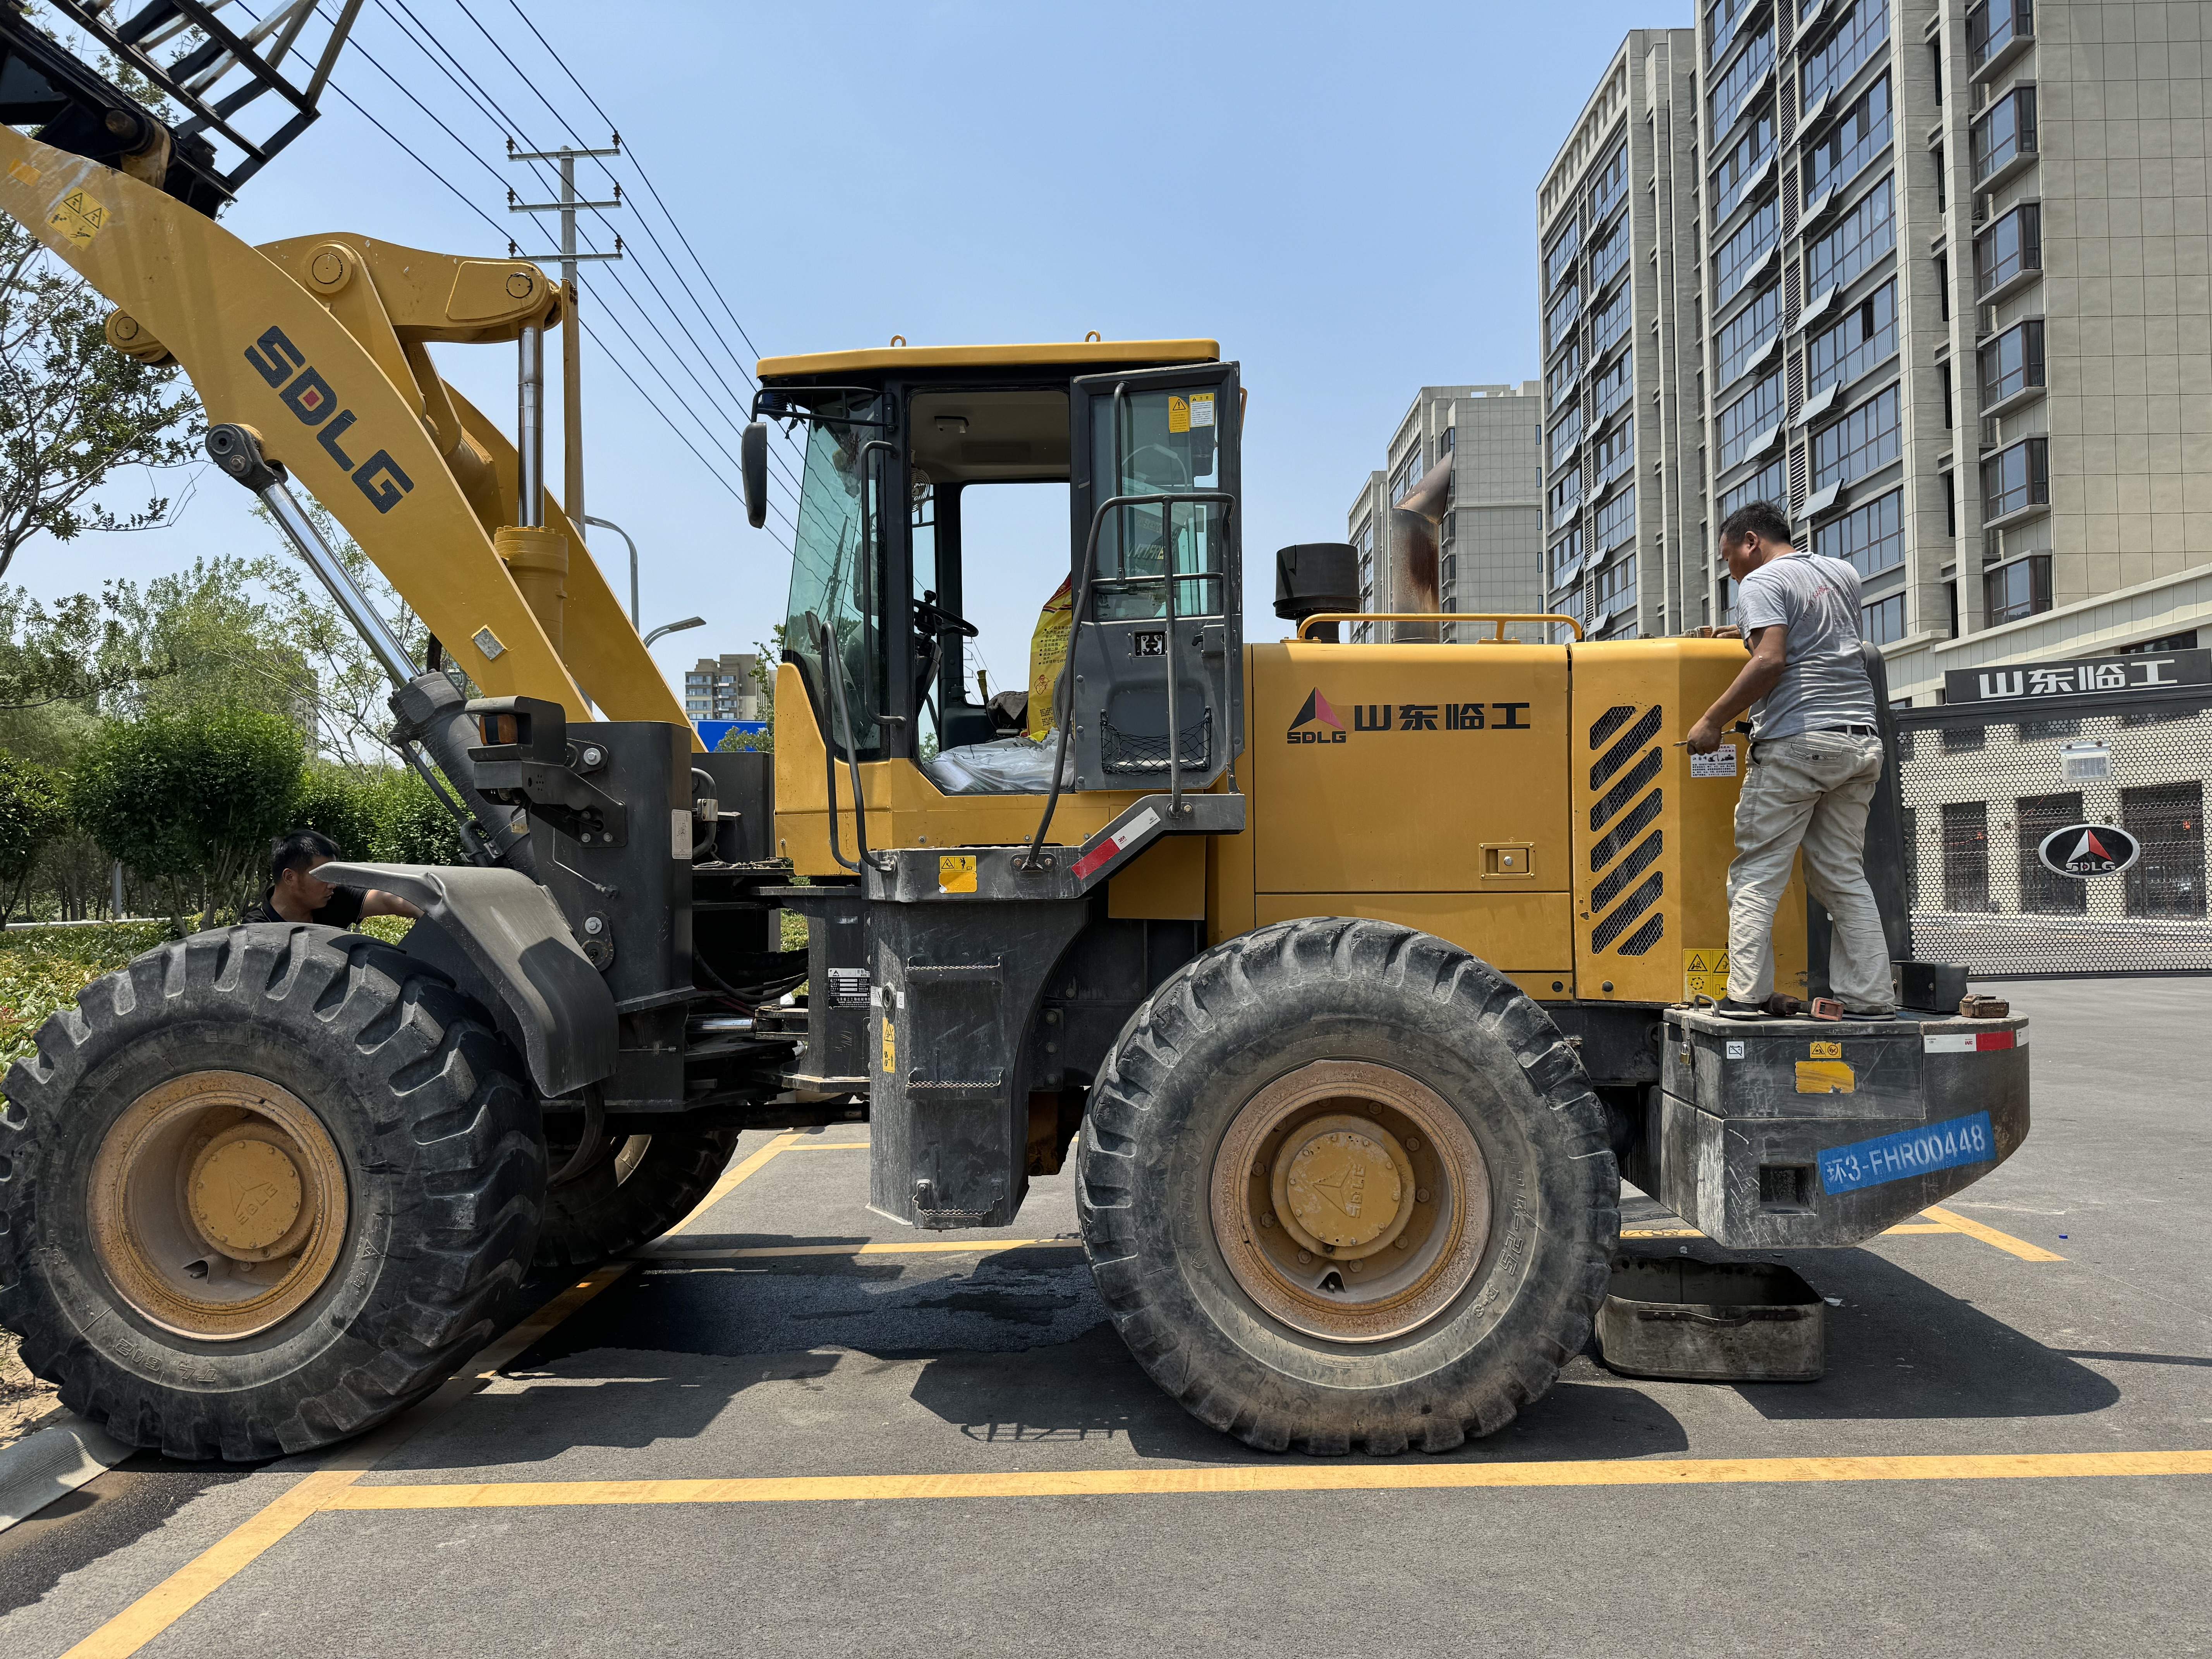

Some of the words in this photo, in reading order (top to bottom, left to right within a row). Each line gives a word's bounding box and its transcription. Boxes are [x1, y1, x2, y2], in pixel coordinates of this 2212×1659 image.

[244, 325, 414, 514] SDLG
[1979, 659, 2177, 699] 山东临工
[1354, 702, 1530, 731] 山东临工
[1287, 731, 1346, 744] SDLG
[2066, 862, 2116, 872] SDLG
[1825, 1125, 1985, 1183] 环3-FHR00448
[235, 1183, 278, 1225] SDLG
[1349, 1164, 1366, 1218] SDLG
[116, 1338, 163, 1371] 612
